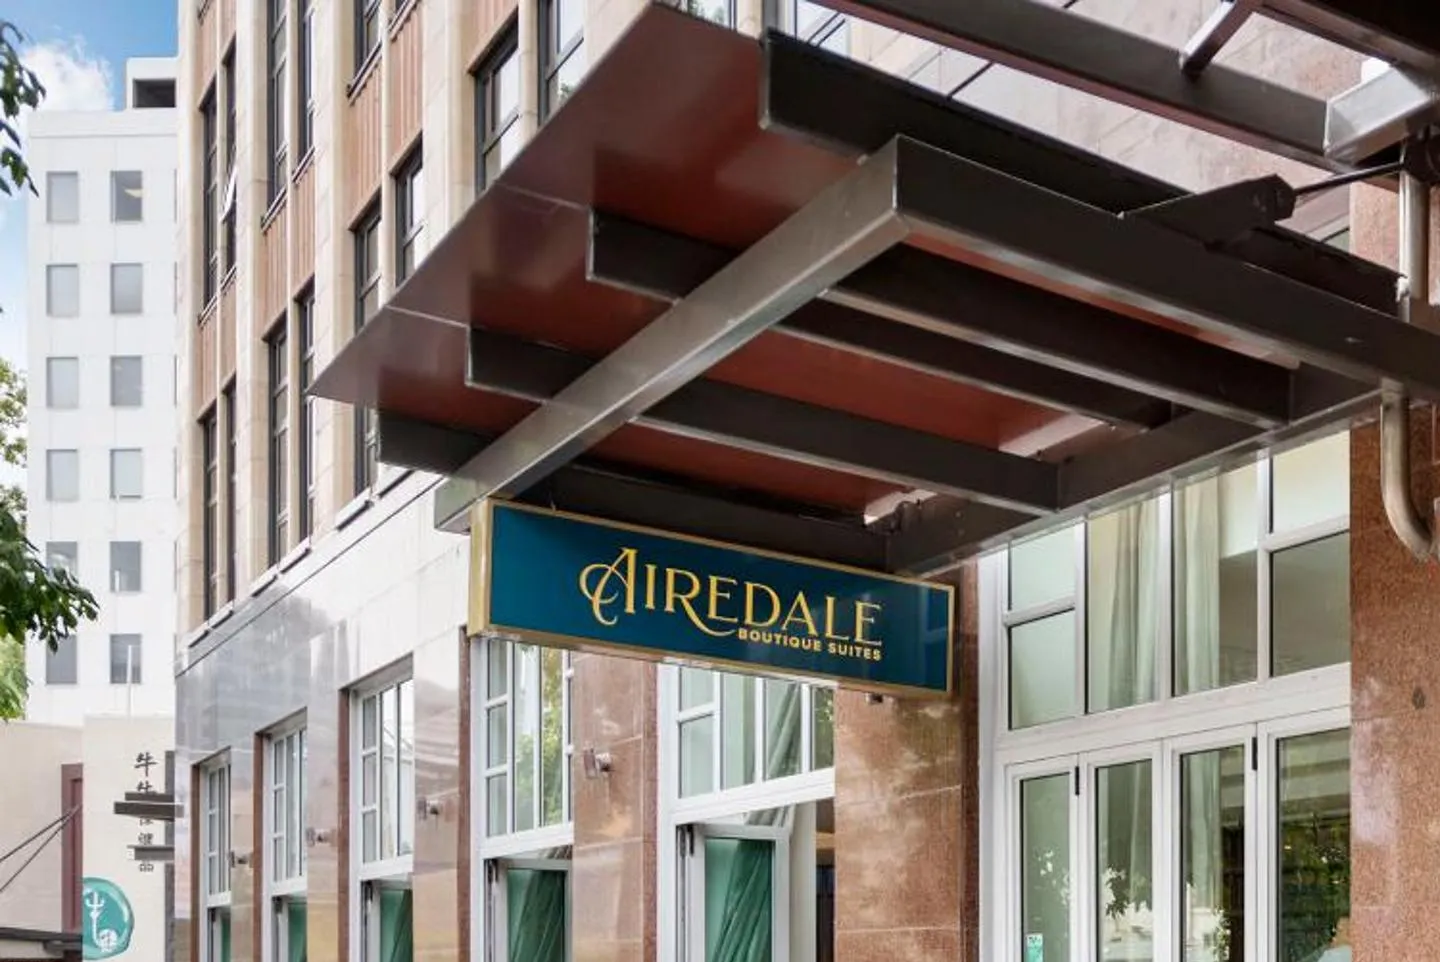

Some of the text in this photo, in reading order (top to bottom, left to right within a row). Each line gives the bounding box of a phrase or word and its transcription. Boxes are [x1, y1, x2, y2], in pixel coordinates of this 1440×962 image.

[579, 547, 883, 646] AIREDALE
[738, 628, 882, 661] BOUTIQUE SUITES
